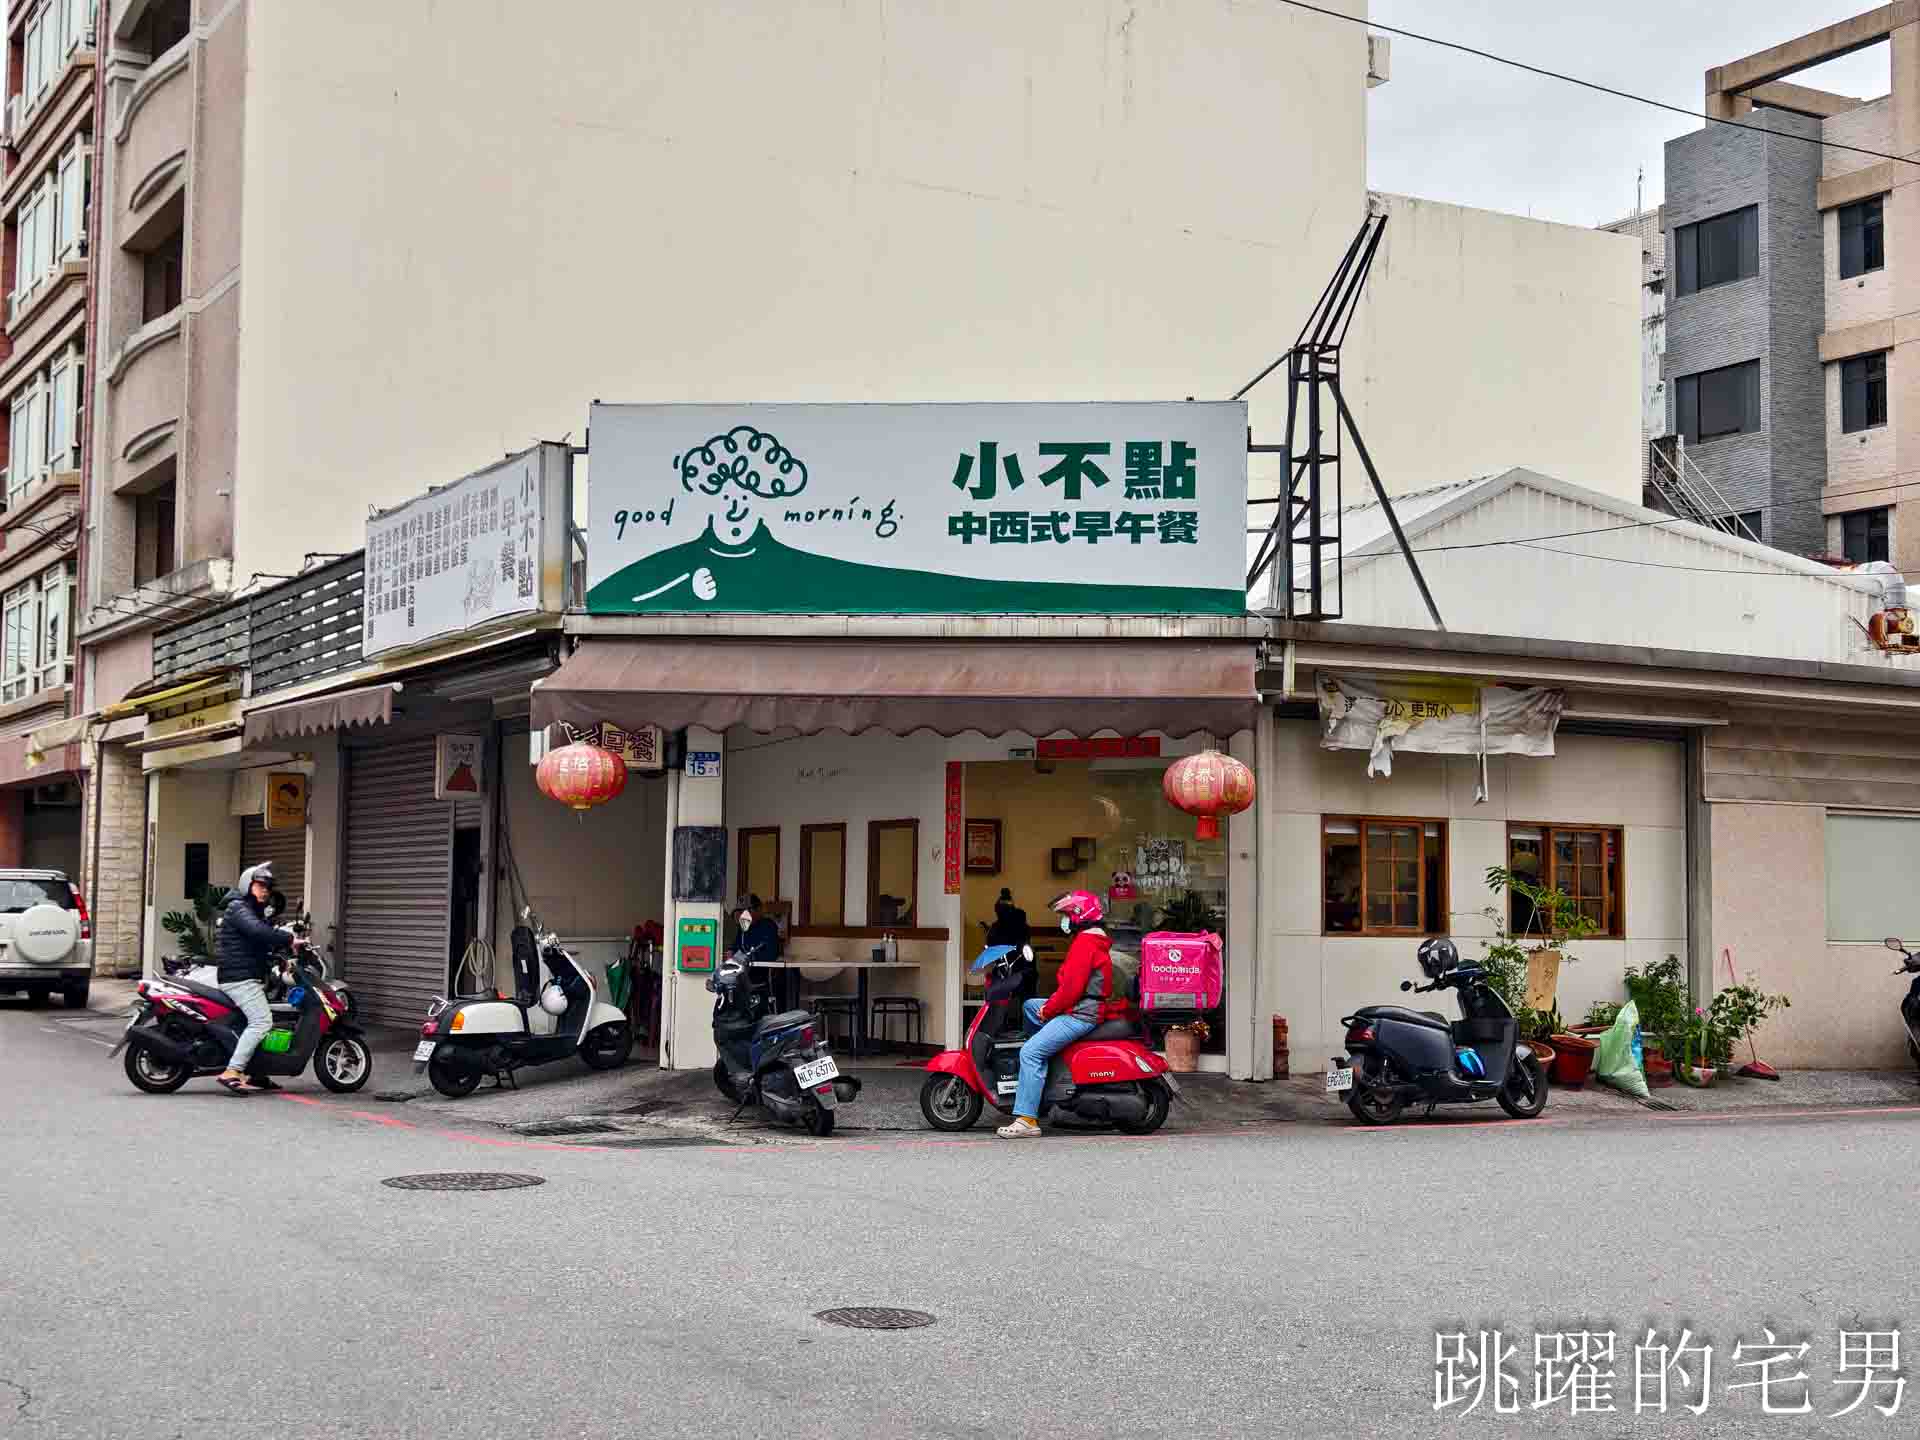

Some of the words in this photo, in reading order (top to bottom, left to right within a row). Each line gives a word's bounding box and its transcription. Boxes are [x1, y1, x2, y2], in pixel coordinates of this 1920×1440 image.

[952, 441, 1198, 500] 小不點
[613, 497, 675, 540] good
[947, 511, 1199, 545] 中西式早午餐
[1410, 701, 1456, 718] 更放心
[1151, 963, 1201, 976] foodpanda
